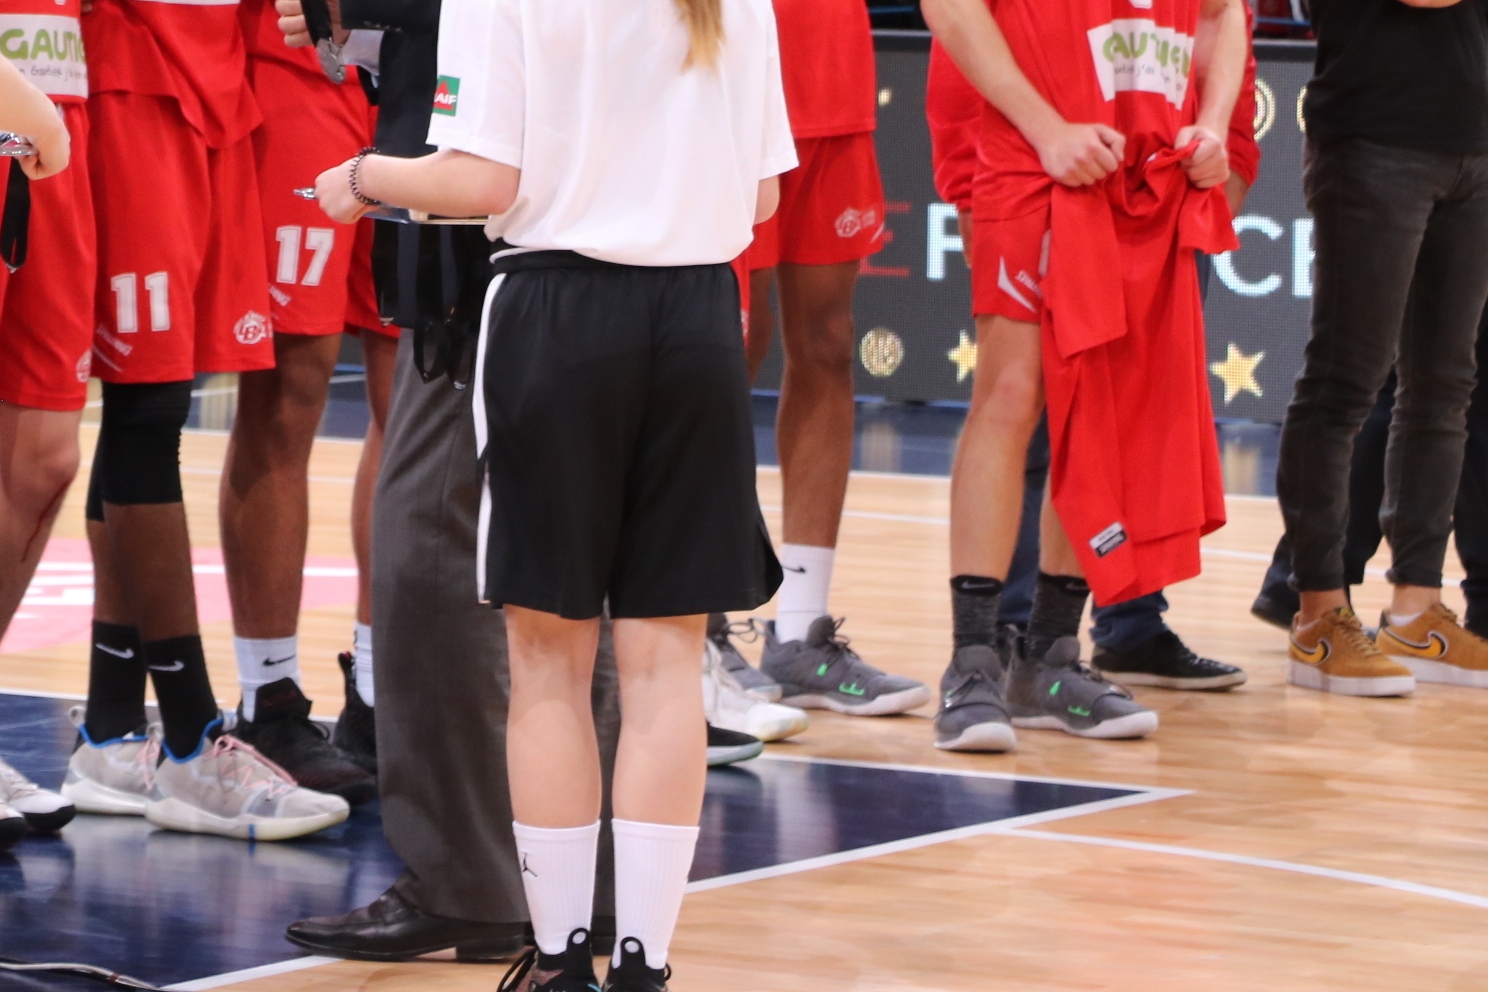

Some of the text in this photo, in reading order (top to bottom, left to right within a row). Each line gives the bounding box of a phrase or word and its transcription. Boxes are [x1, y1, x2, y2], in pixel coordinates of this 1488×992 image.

[434, 92, 458, 106] AIF
[275, 224, 335, 286] 17
[111, 271, 171, 333] 11
